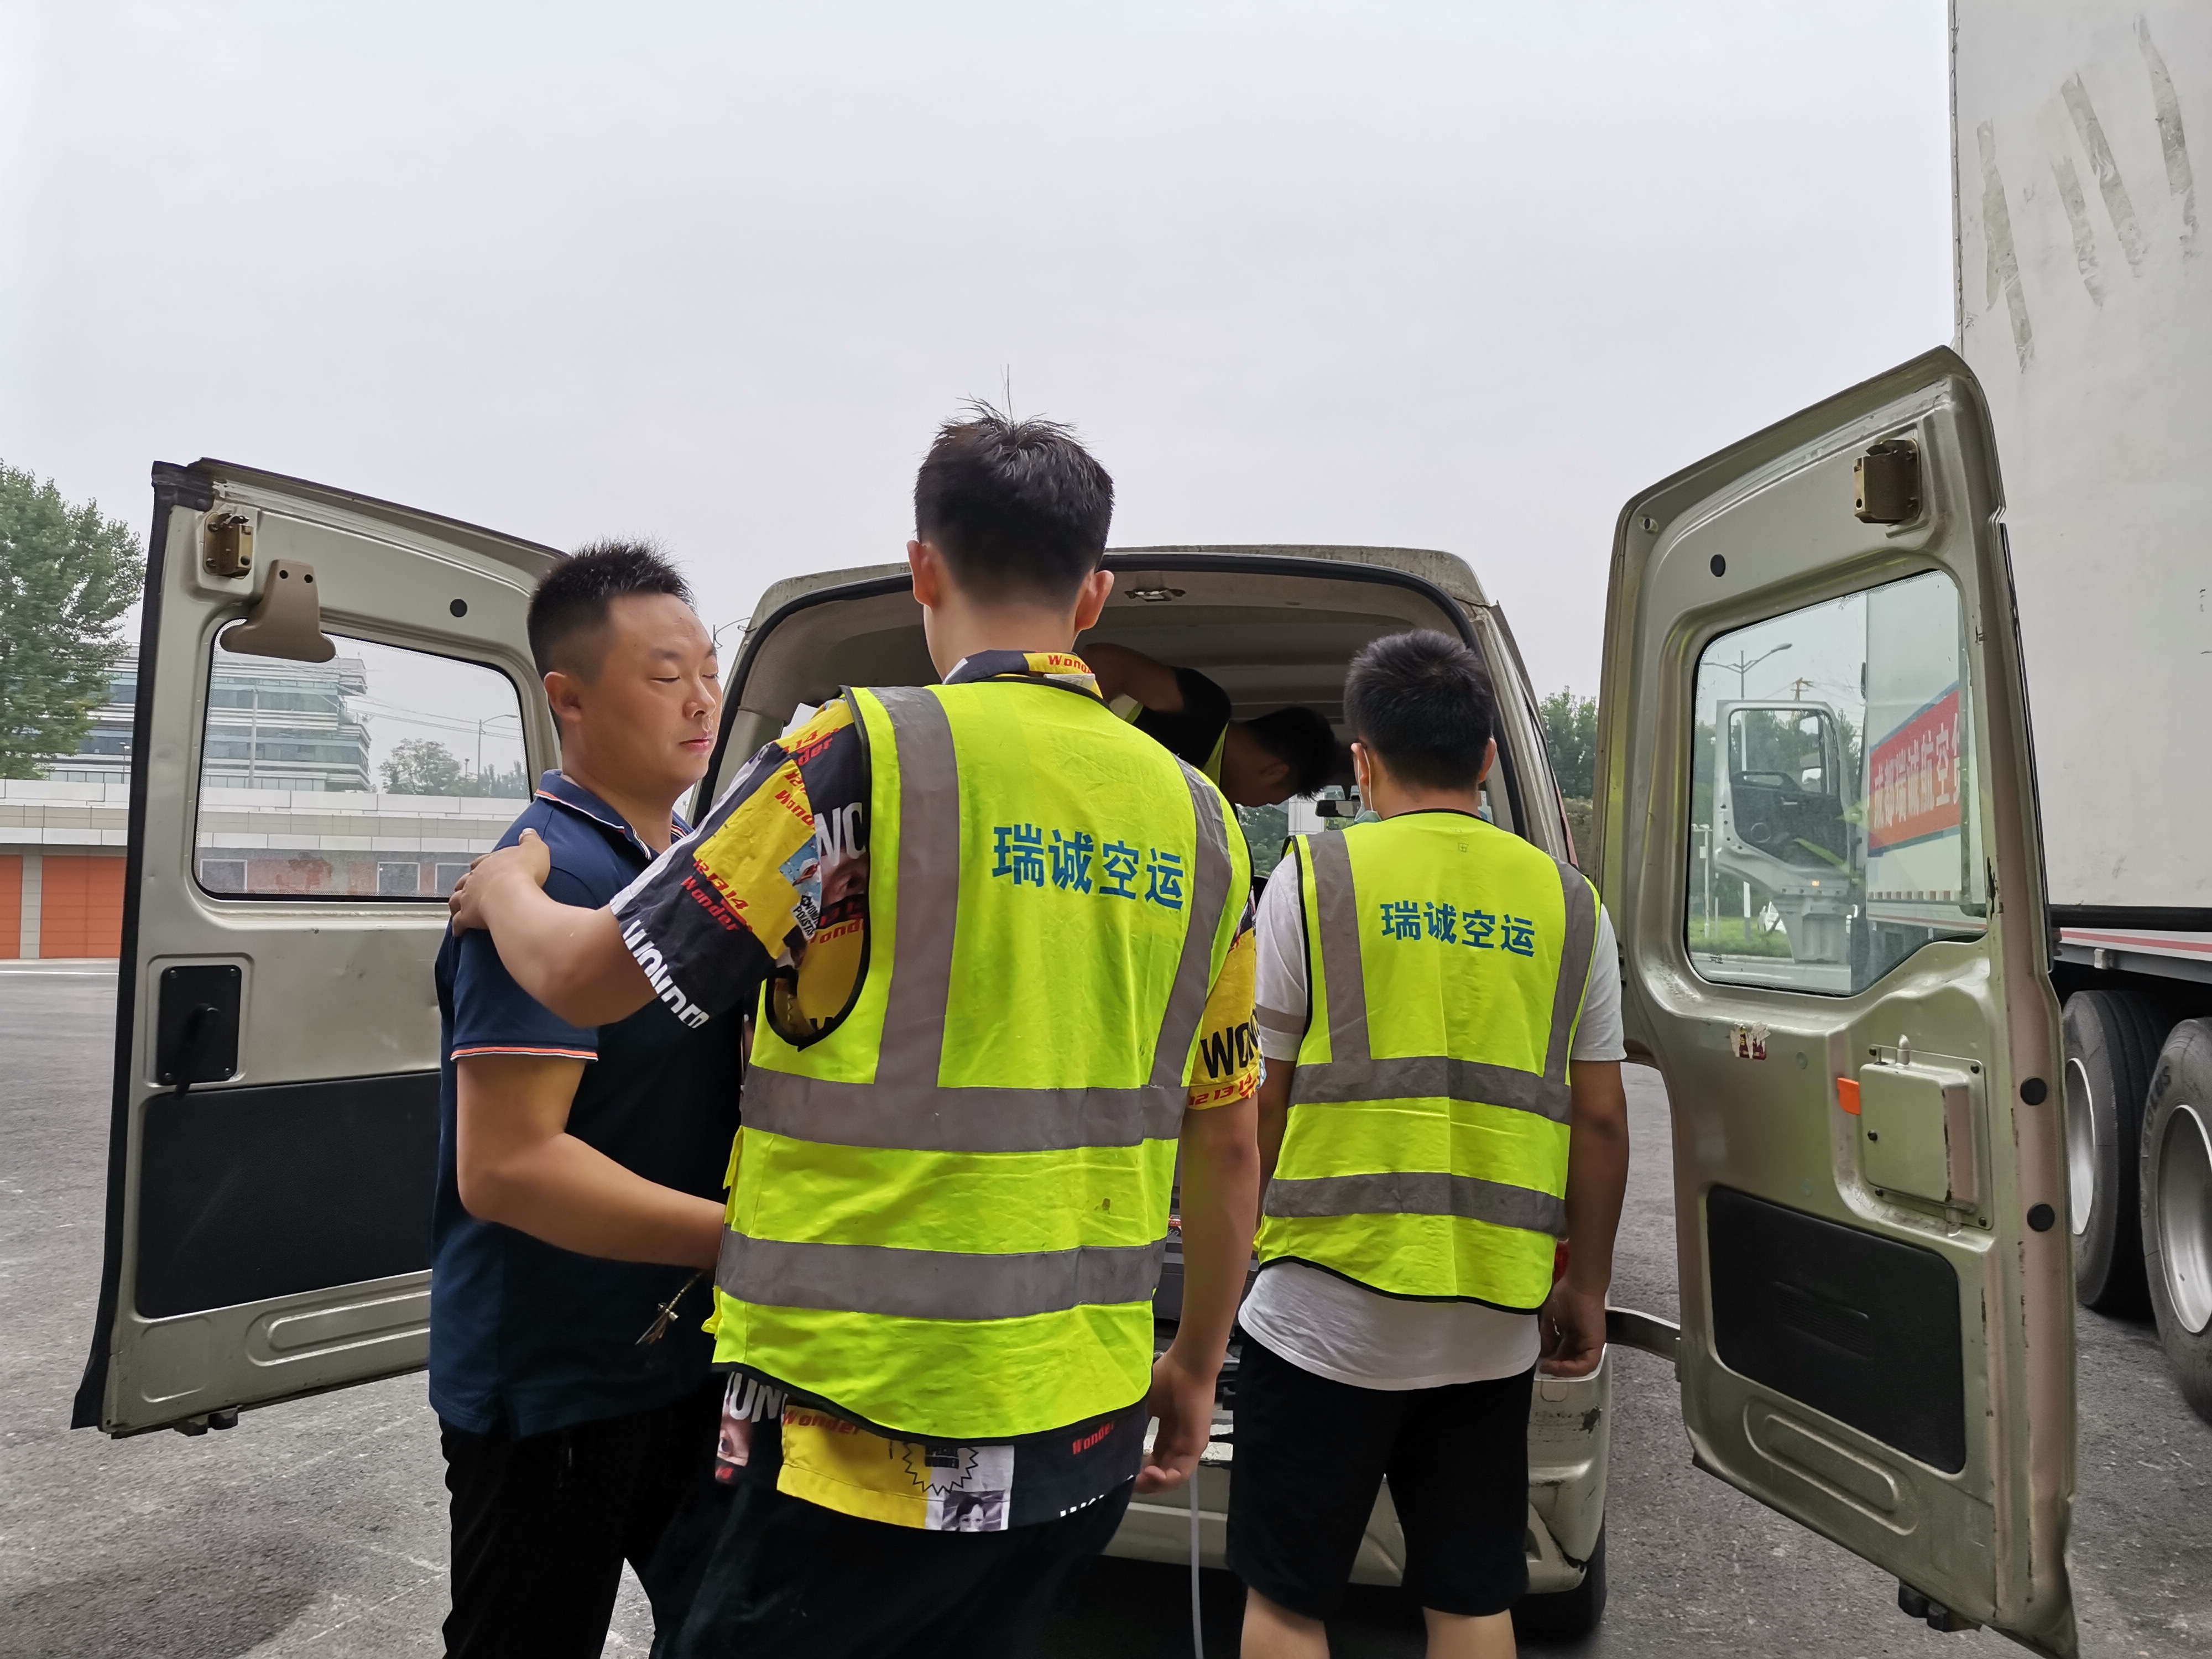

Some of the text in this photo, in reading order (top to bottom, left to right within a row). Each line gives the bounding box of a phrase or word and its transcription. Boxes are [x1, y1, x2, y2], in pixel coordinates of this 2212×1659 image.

[992, 823, 1183, 910] 瑞诚空运
[1380, 900, 1535, 957] 瑞诚空运
